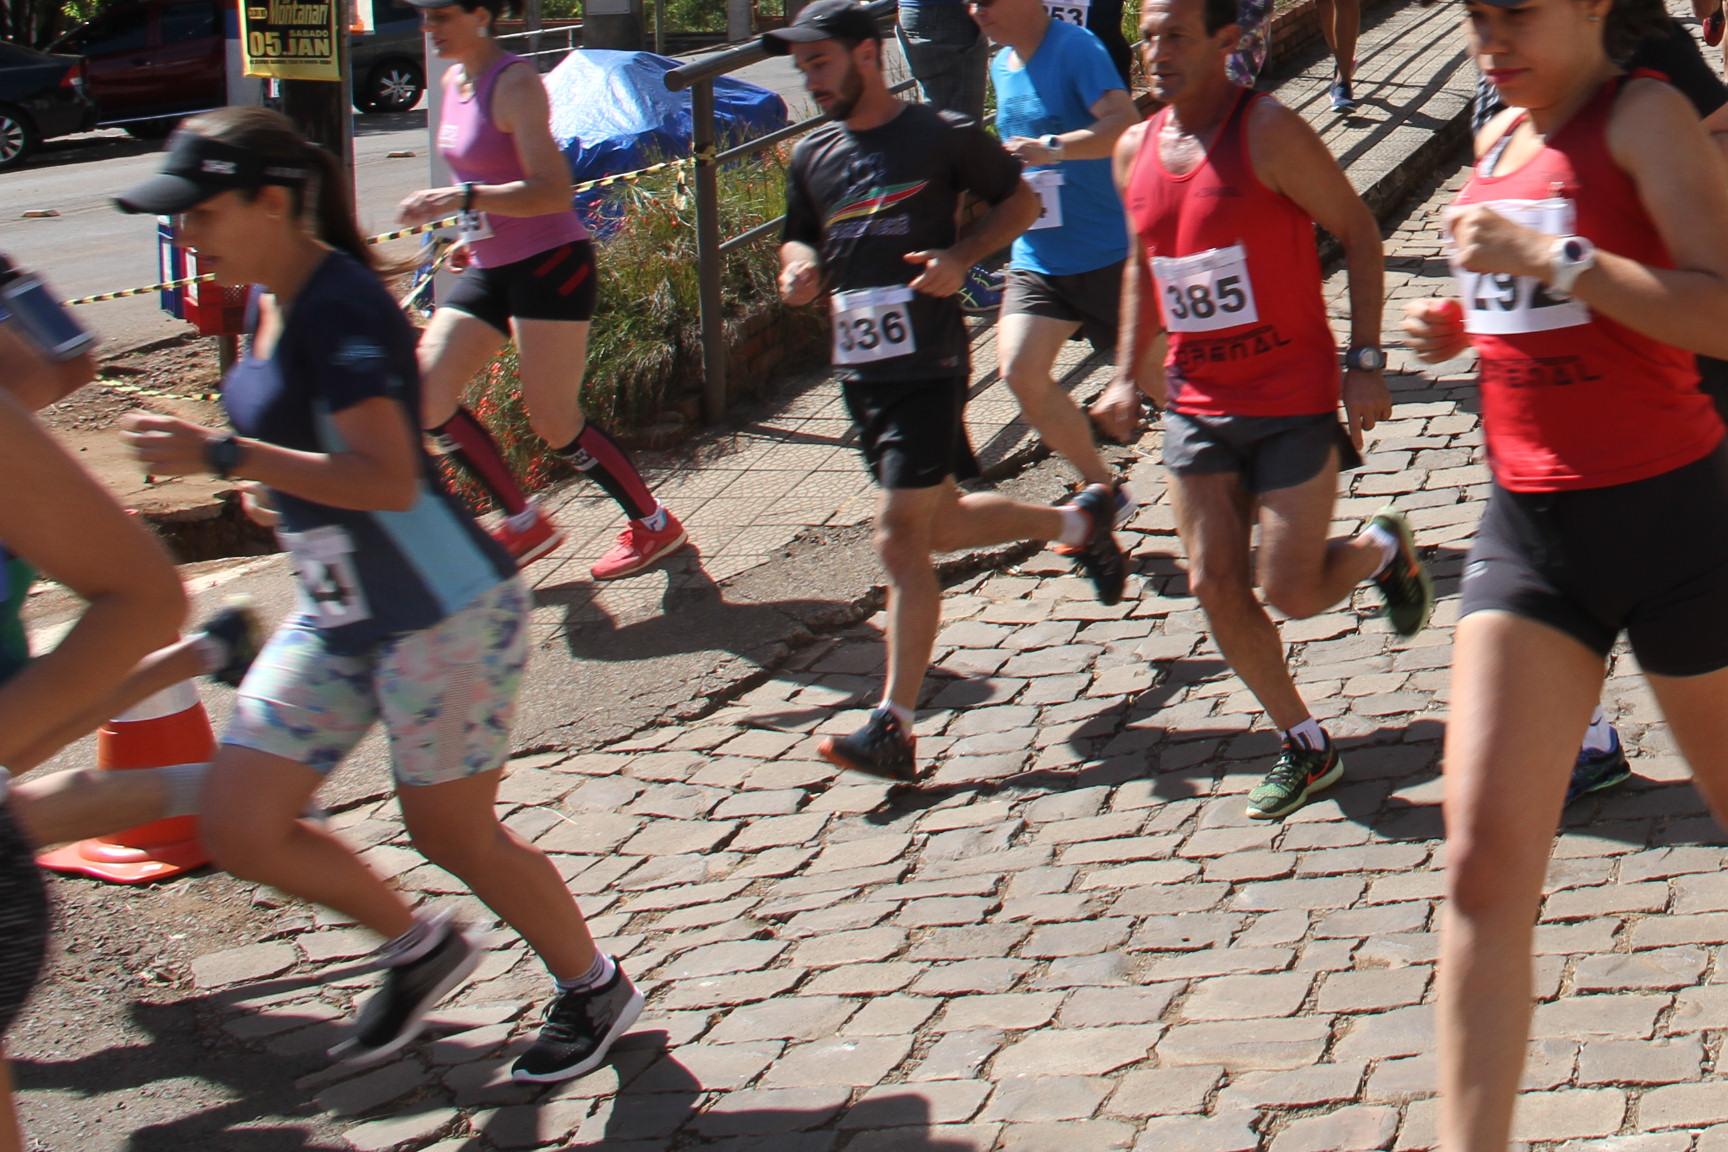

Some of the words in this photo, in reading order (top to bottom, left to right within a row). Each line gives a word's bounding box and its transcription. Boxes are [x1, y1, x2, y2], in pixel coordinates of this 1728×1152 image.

[1043, 5, 1084, 27] 53
[1167, 275, 1246, 320] 385
[838, 311, 906, 352] 336
